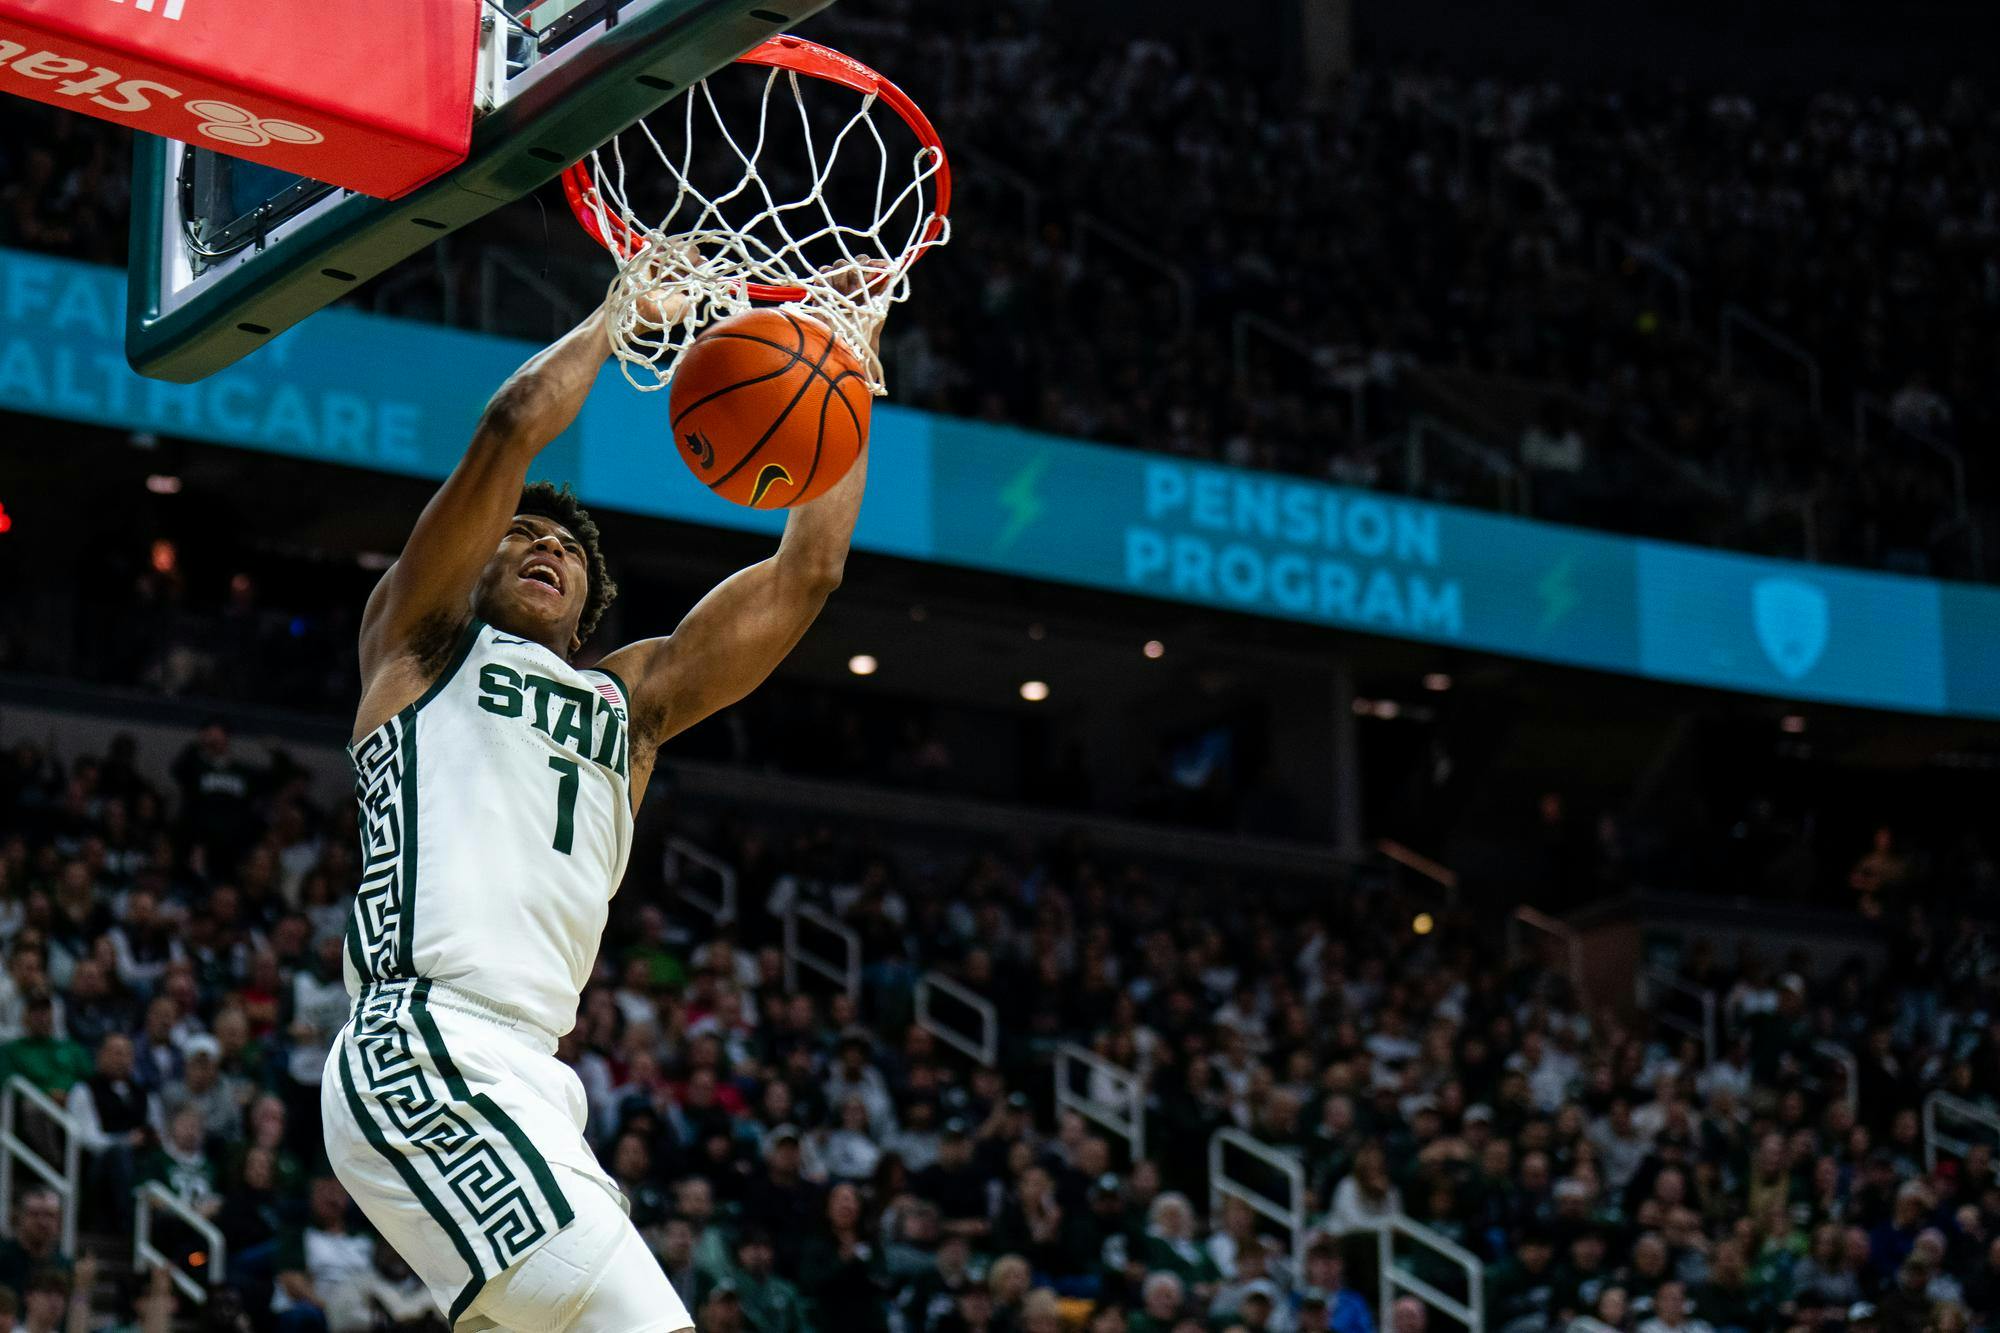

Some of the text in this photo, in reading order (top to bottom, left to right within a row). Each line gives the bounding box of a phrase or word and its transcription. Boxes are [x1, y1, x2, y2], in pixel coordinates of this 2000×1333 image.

[1144, 461, 1440, 566] PENSION
[1123, 526, 1463, 639] PROGRAM
[549, 756, 580, 856] 1
